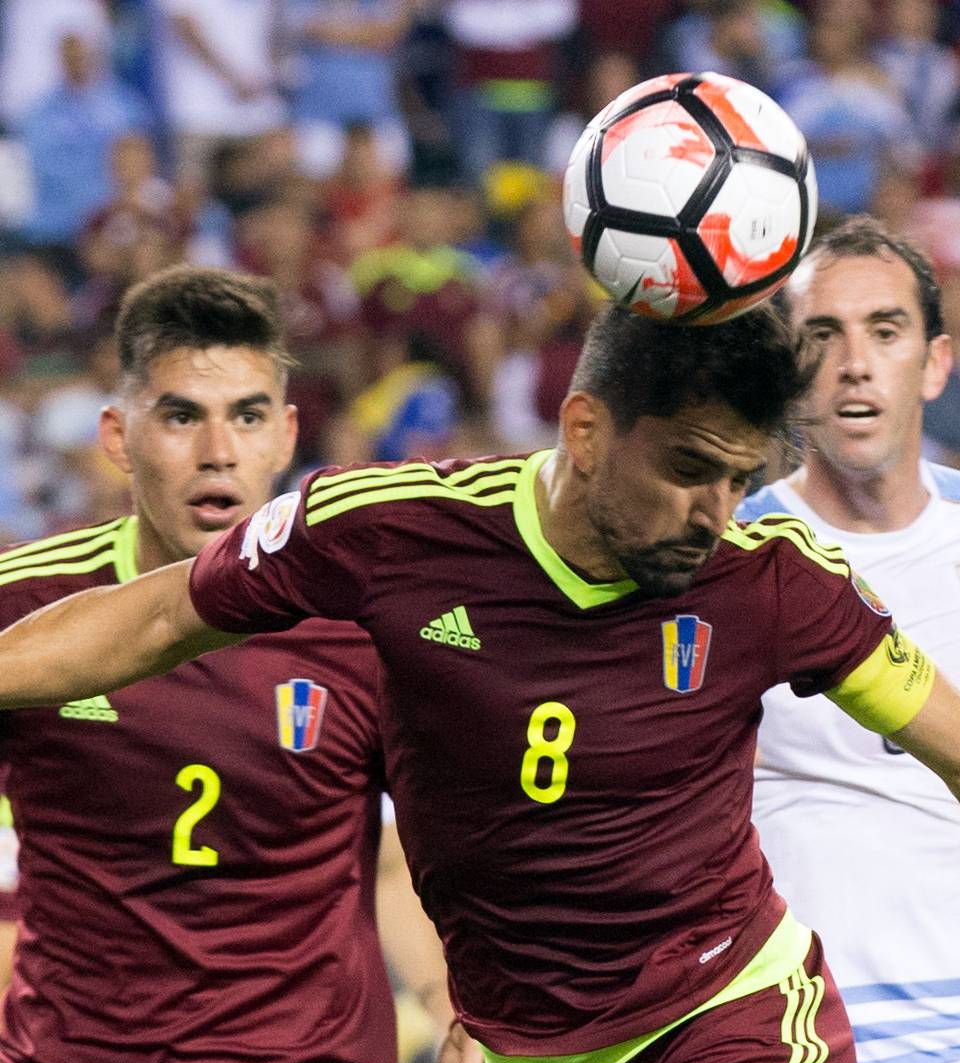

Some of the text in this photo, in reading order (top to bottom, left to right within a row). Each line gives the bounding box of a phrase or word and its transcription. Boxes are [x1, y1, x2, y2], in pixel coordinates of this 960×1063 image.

[420, 627, 481, 650] adidas
[672, 643, 701, 668] FVF
[904, 670, 917, 691] COPA
[59, 706, 119, 722] adidas
[521, 701, 576, 804] 8
[173, 764, 221, 866] 2
